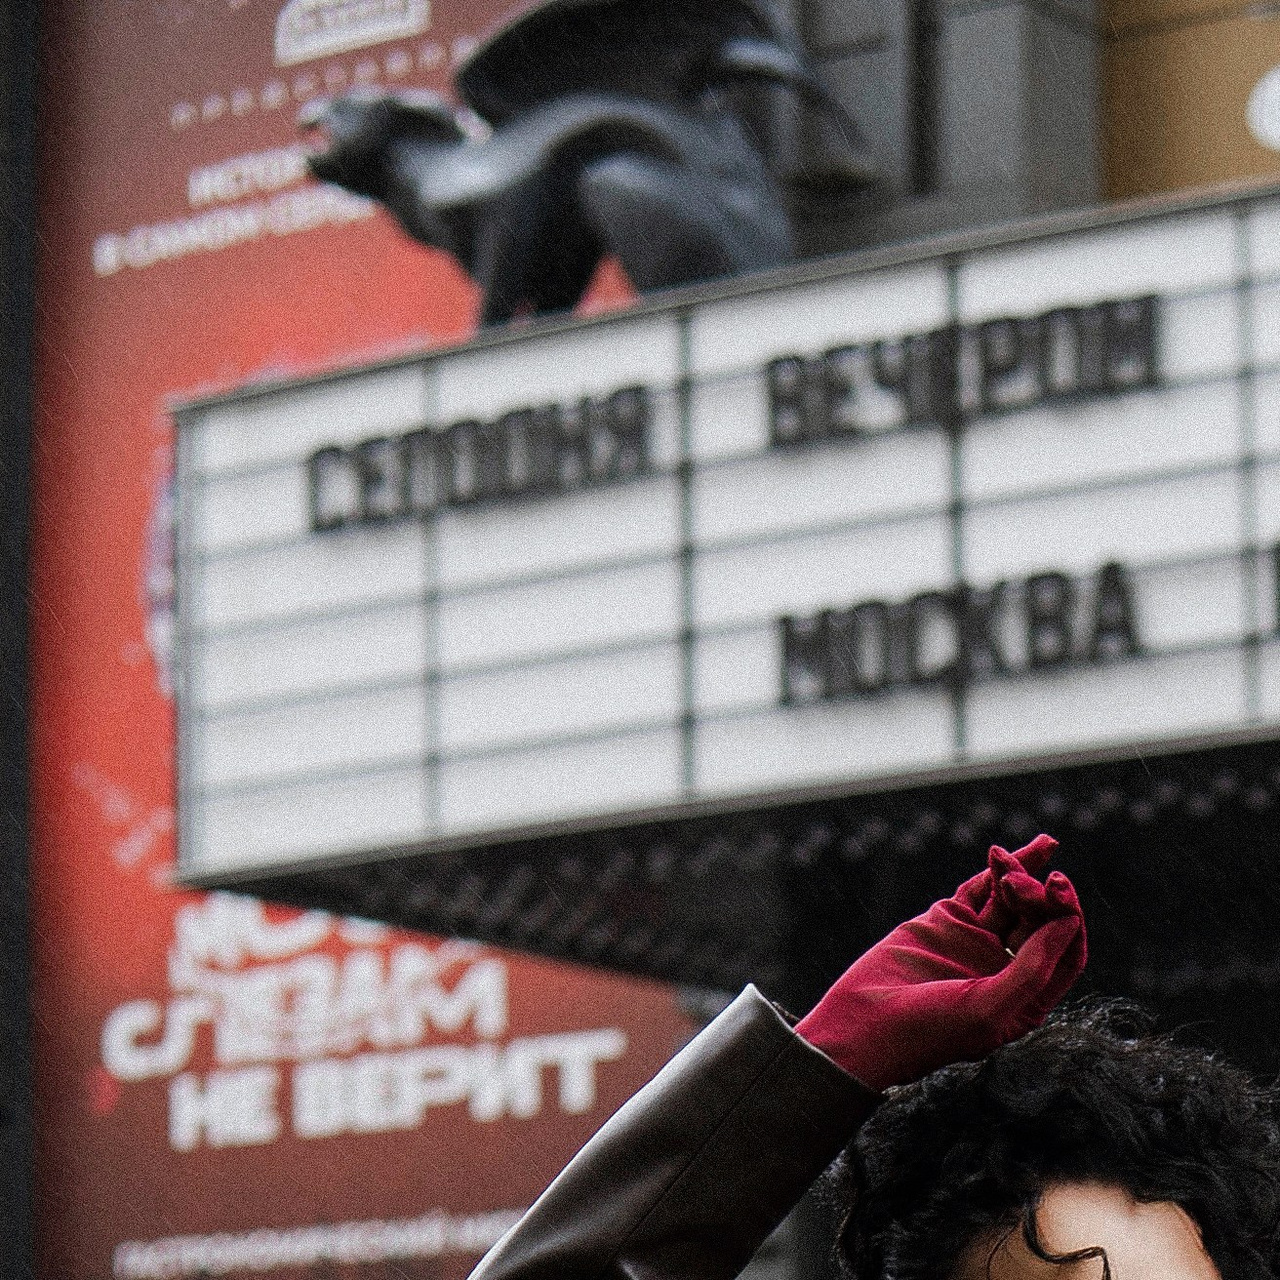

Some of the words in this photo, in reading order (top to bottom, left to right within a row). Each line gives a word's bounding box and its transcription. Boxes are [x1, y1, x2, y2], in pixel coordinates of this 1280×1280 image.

[764, 292, 1161, 451] ВЕЧЕРОМ
[777, 560, 1145, 708] МОСКВА
[168, 1065, 281, 1154] НЕ
[292, 1027, 629, 1140] ВЕРИТ
